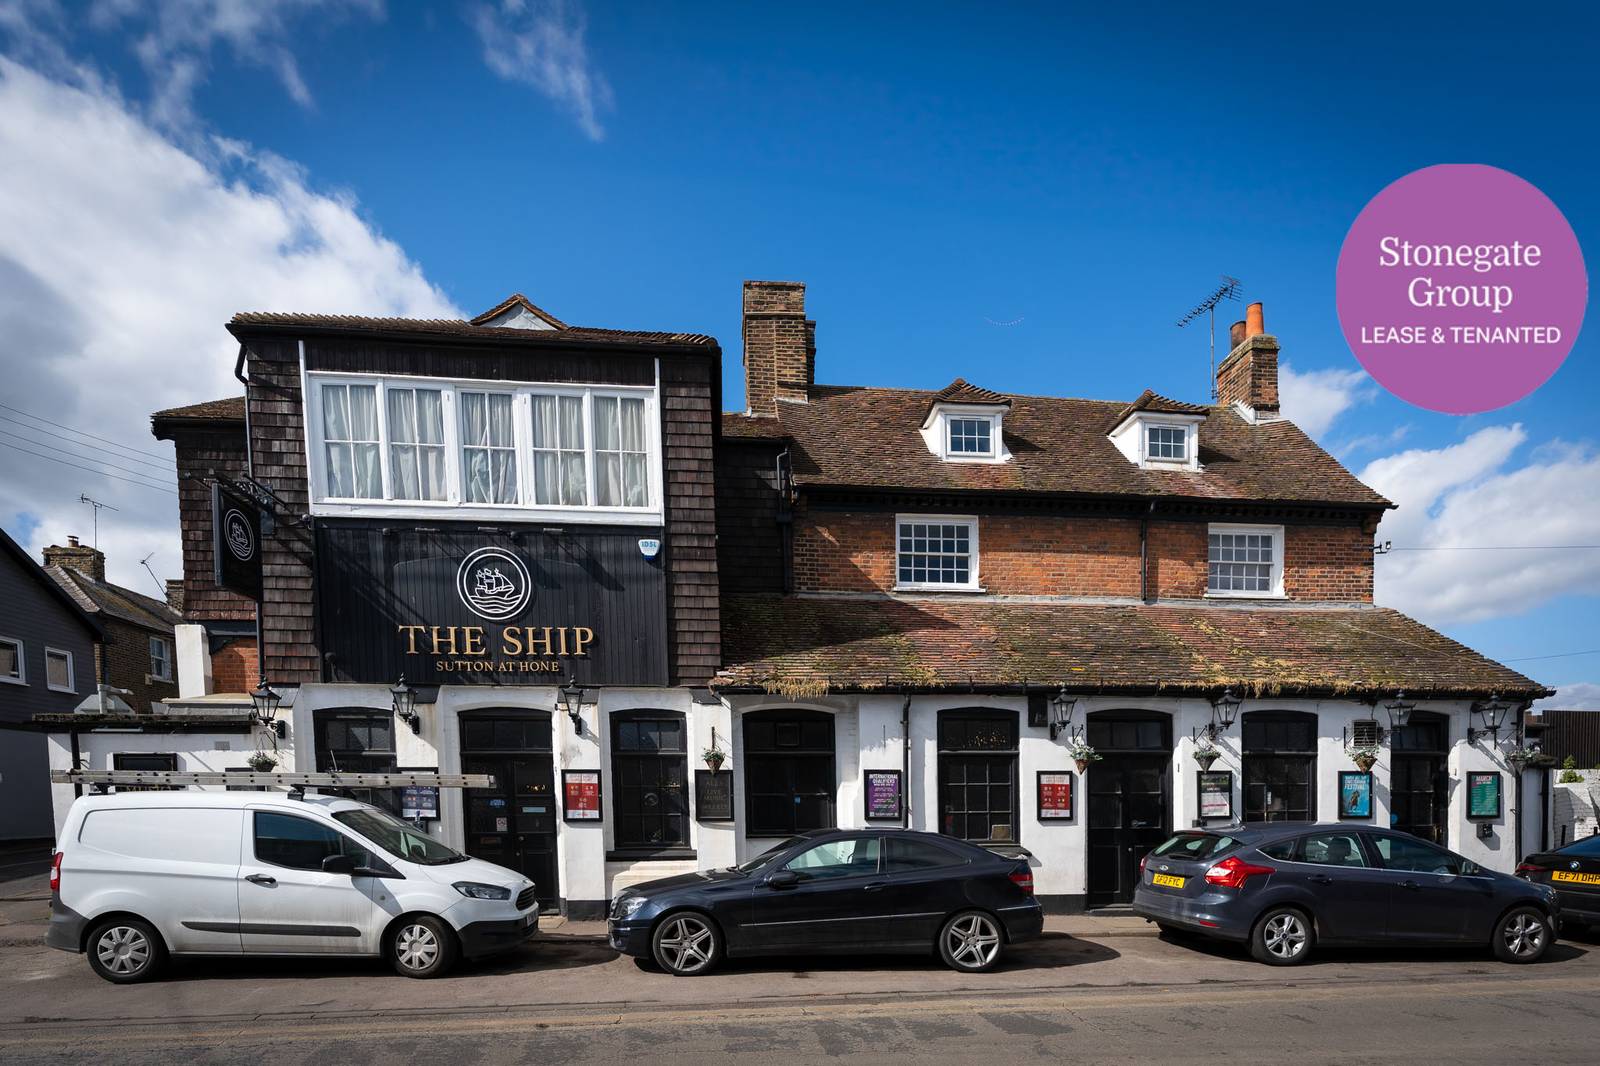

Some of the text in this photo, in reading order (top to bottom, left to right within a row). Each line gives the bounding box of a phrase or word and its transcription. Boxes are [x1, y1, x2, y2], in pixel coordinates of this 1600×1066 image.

[398, 625, 595, 656] THE SHIP
[436, 660, 560, 672] SUTTON AT HONE
[1558, 871, 1600, 883] EF71 DHP
